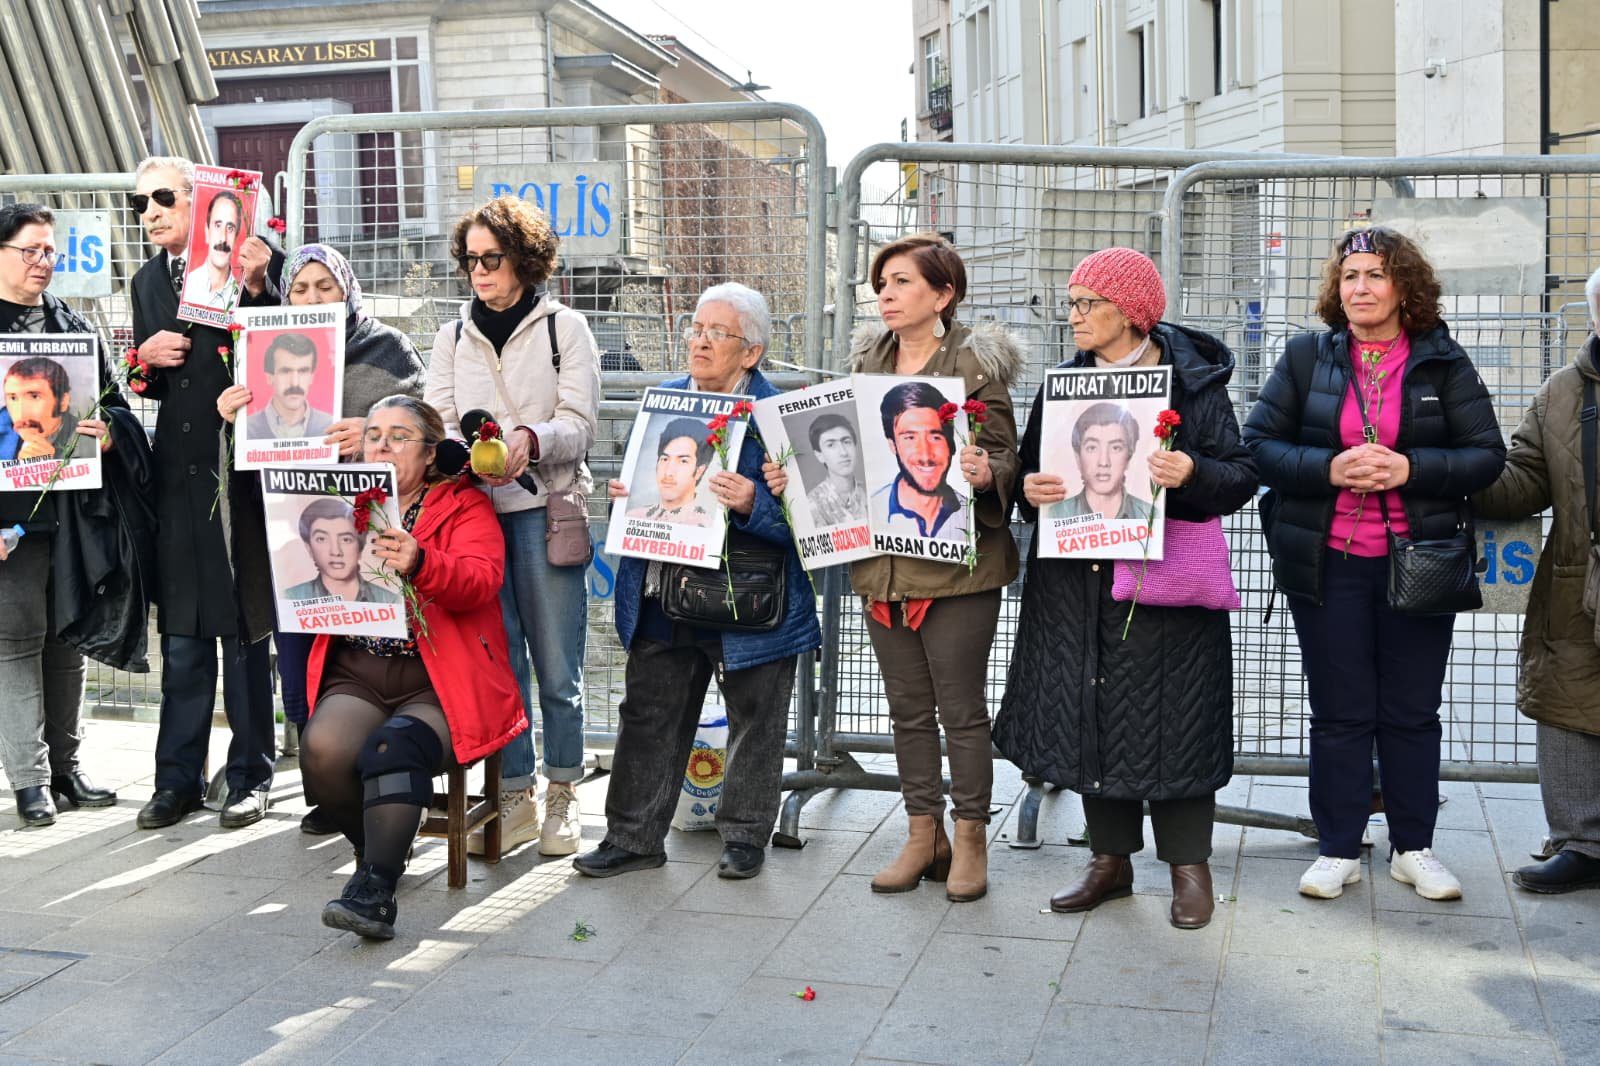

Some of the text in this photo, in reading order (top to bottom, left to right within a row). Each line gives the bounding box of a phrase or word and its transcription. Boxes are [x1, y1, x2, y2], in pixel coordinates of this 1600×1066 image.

[208, 39, 376, 66] ATASARAY LİSESİ
[195, 170, 226, 185] KENAN
[491, 175, 611, 237] LİS
[248, 312, 336, 327] FEHMİ TOSUN
[30, 342, 88, 353] KIRBAYIR
[1051, 373, 1163, 396] MURAT YILDIZ
[646, 393, 741, 416] MURAT YILD
[778, 388, 854, 415] FERHAT TEPE
[269, 471, 388, 493] MURAT YILDIZ
[626, 526, 671, 541] GÖZALTINDA
[1055, 523, 1105, 539] GÖZALTINDA
[622, 536, 705, 561] KAYBEDİLDİ
[874, 534, 970, 561] HASAN OCAK
[295, 604, 347, 617] GÖZALTINDA
[300, 604, 396, 630] KAYBEDİLDİ
